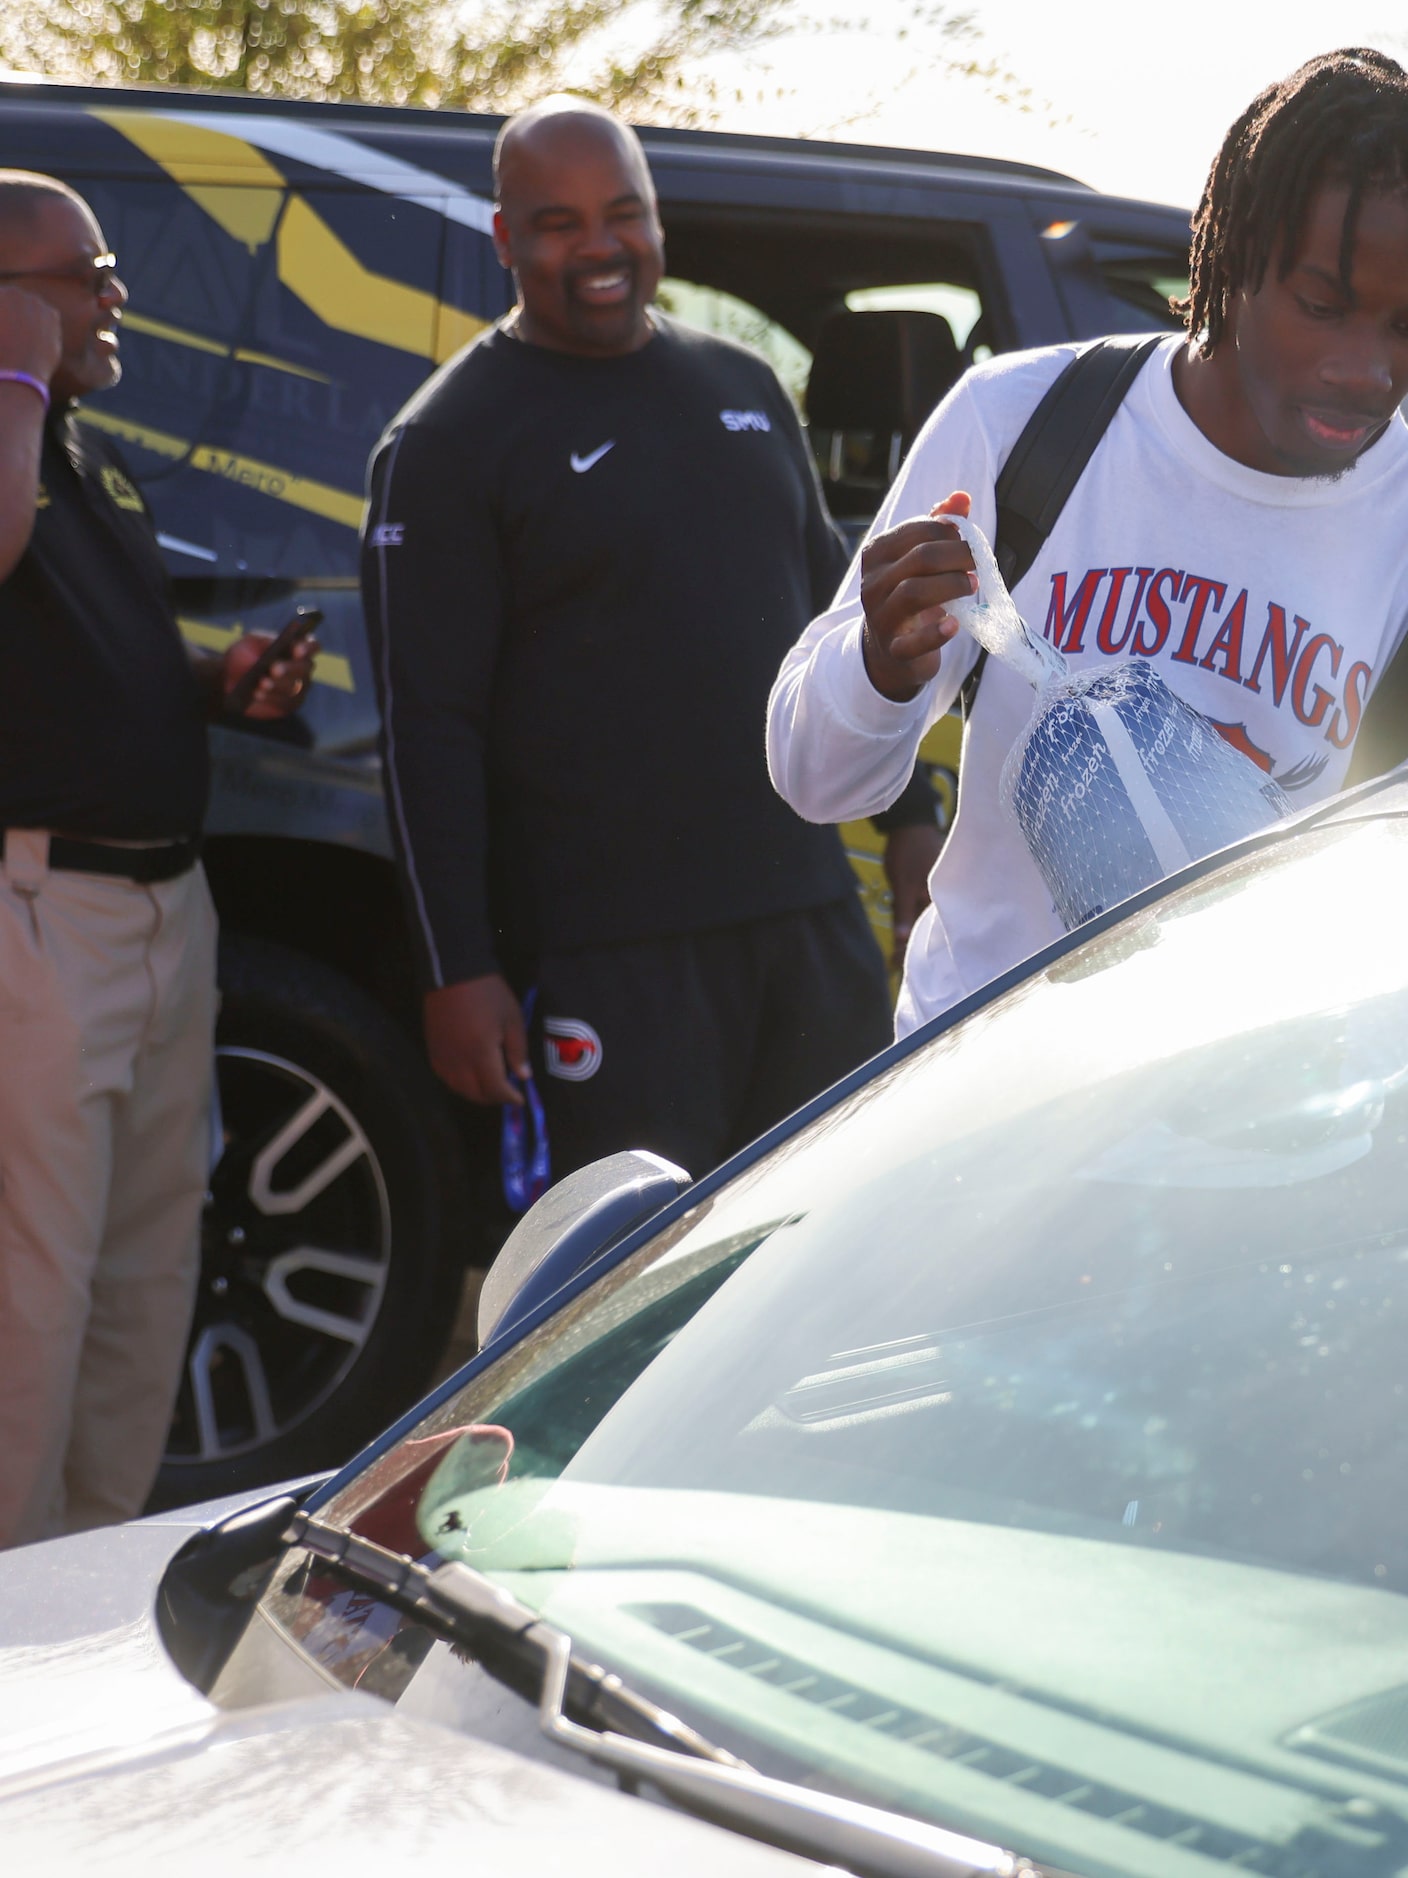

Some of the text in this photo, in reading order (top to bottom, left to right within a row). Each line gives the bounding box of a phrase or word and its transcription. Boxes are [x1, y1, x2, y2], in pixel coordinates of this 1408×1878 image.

[720, 409, 770, 432] SMU
[1044, 567, 1372, 749] MUSTANGS
[1139, 716, 1176, 773] frozen
[1060, 742, 1106, 821] frozen
